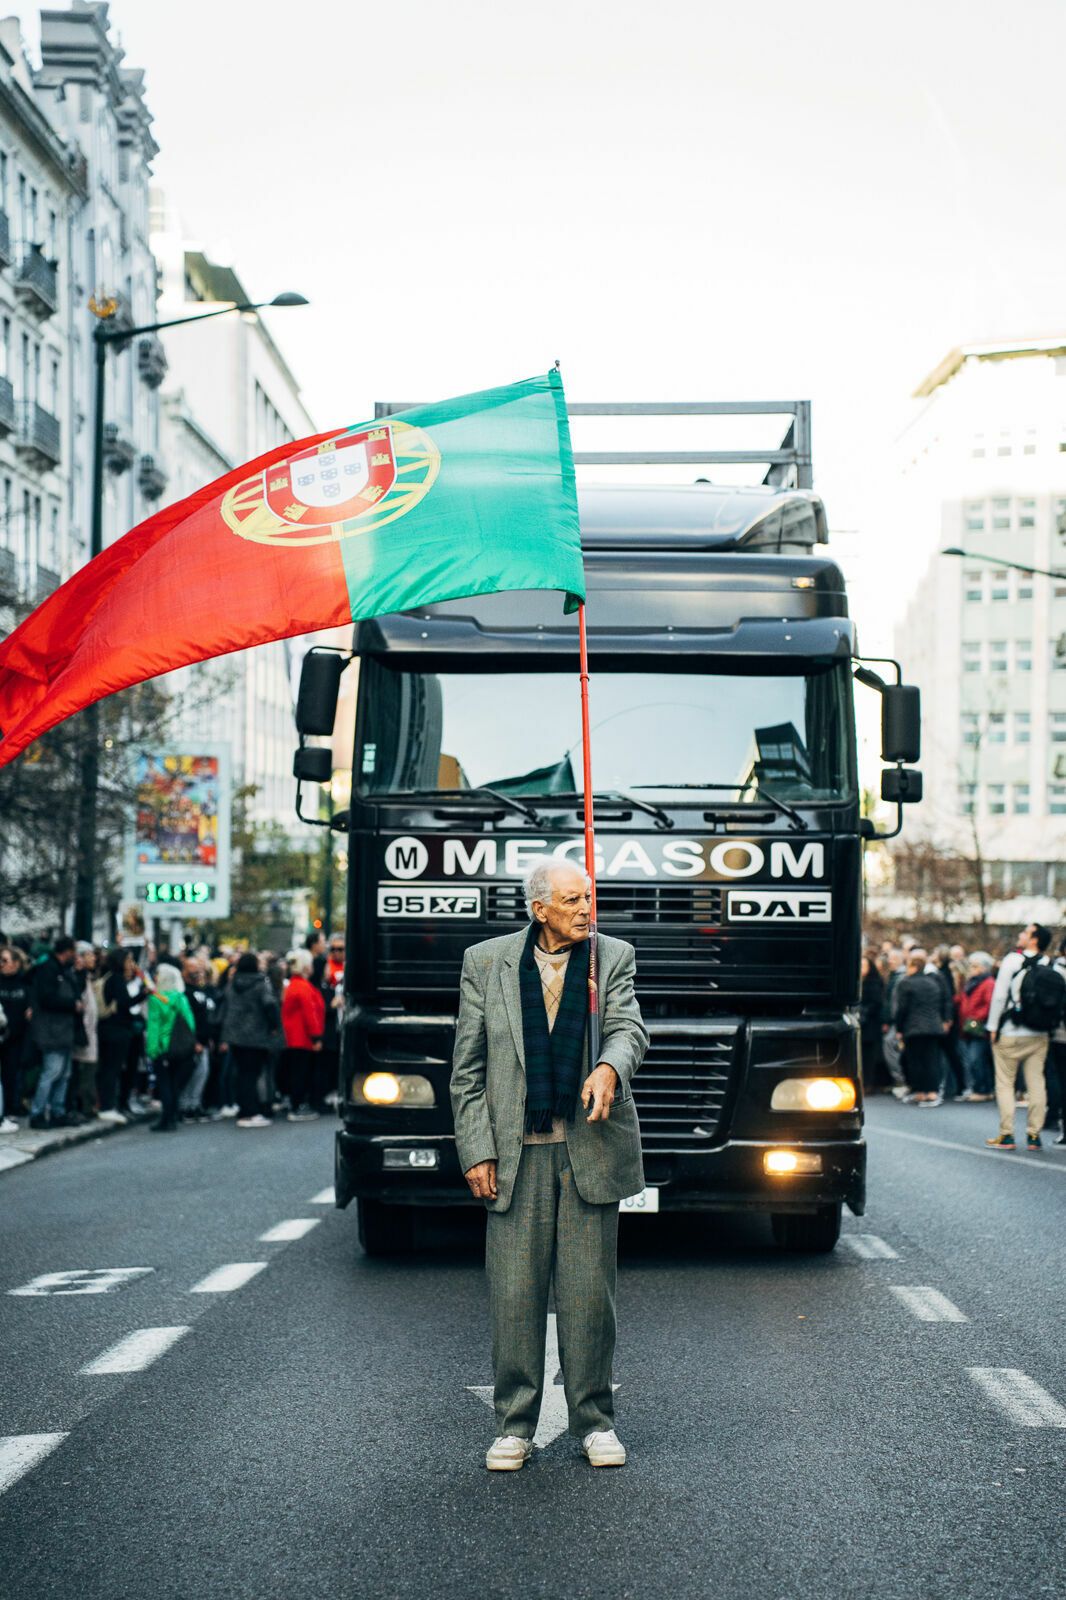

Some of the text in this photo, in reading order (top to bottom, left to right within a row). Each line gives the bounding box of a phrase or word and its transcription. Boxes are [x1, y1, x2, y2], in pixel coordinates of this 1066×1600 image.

[395, 847, 417, 869] M
[146, 882, 209, 902] 14:19
[731, 901, 827, 917] DAF
